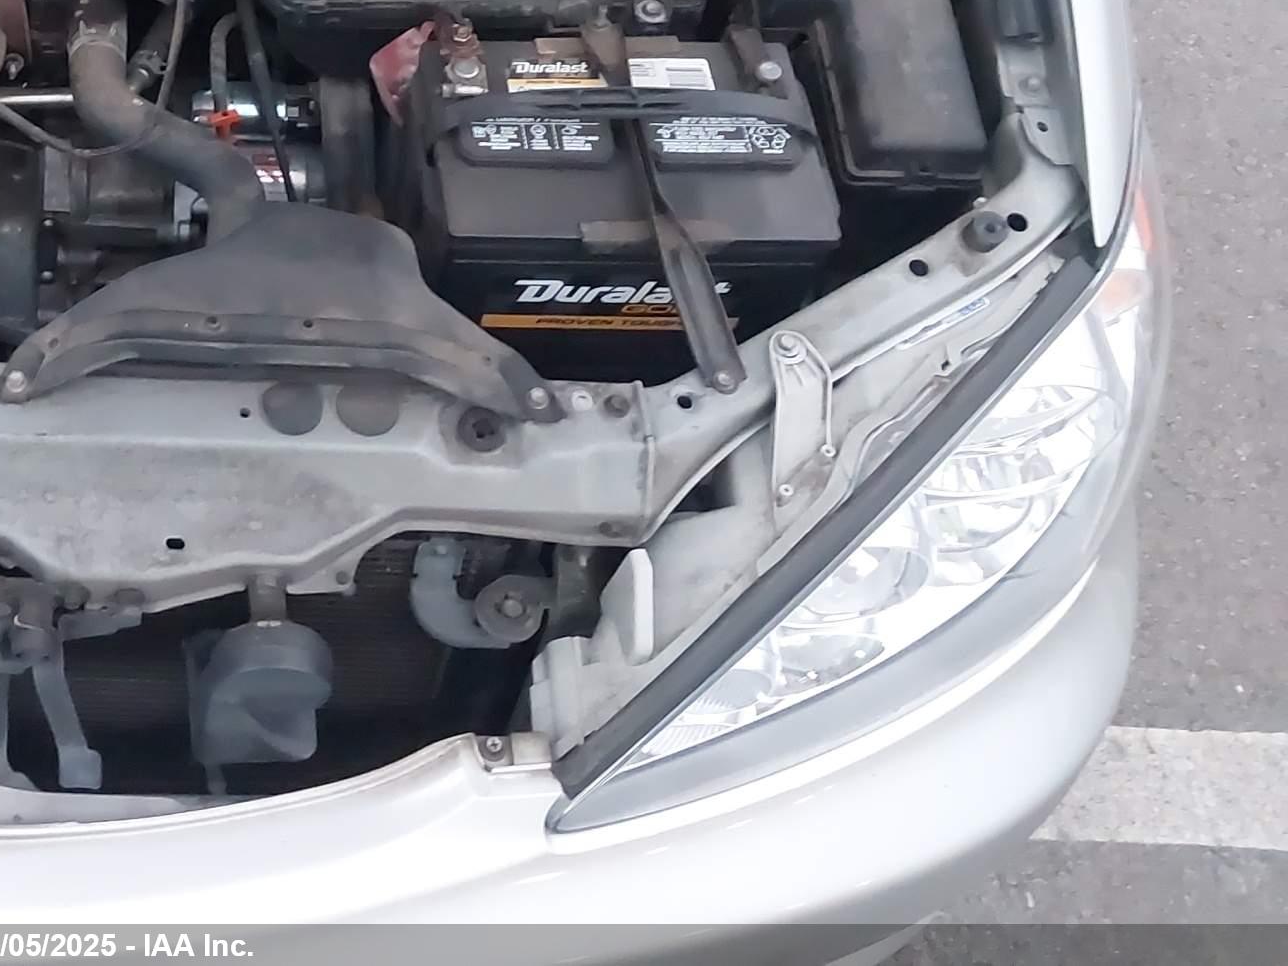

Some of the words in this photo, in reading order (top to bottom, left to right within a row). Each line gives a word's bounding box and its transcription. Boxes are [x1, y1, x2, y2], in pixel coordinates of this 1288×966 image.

[511, 60, 589, 75] Duralast
[513, 279, 732, 305] Duralat
[535, 317, 614, 326] PROVEN
